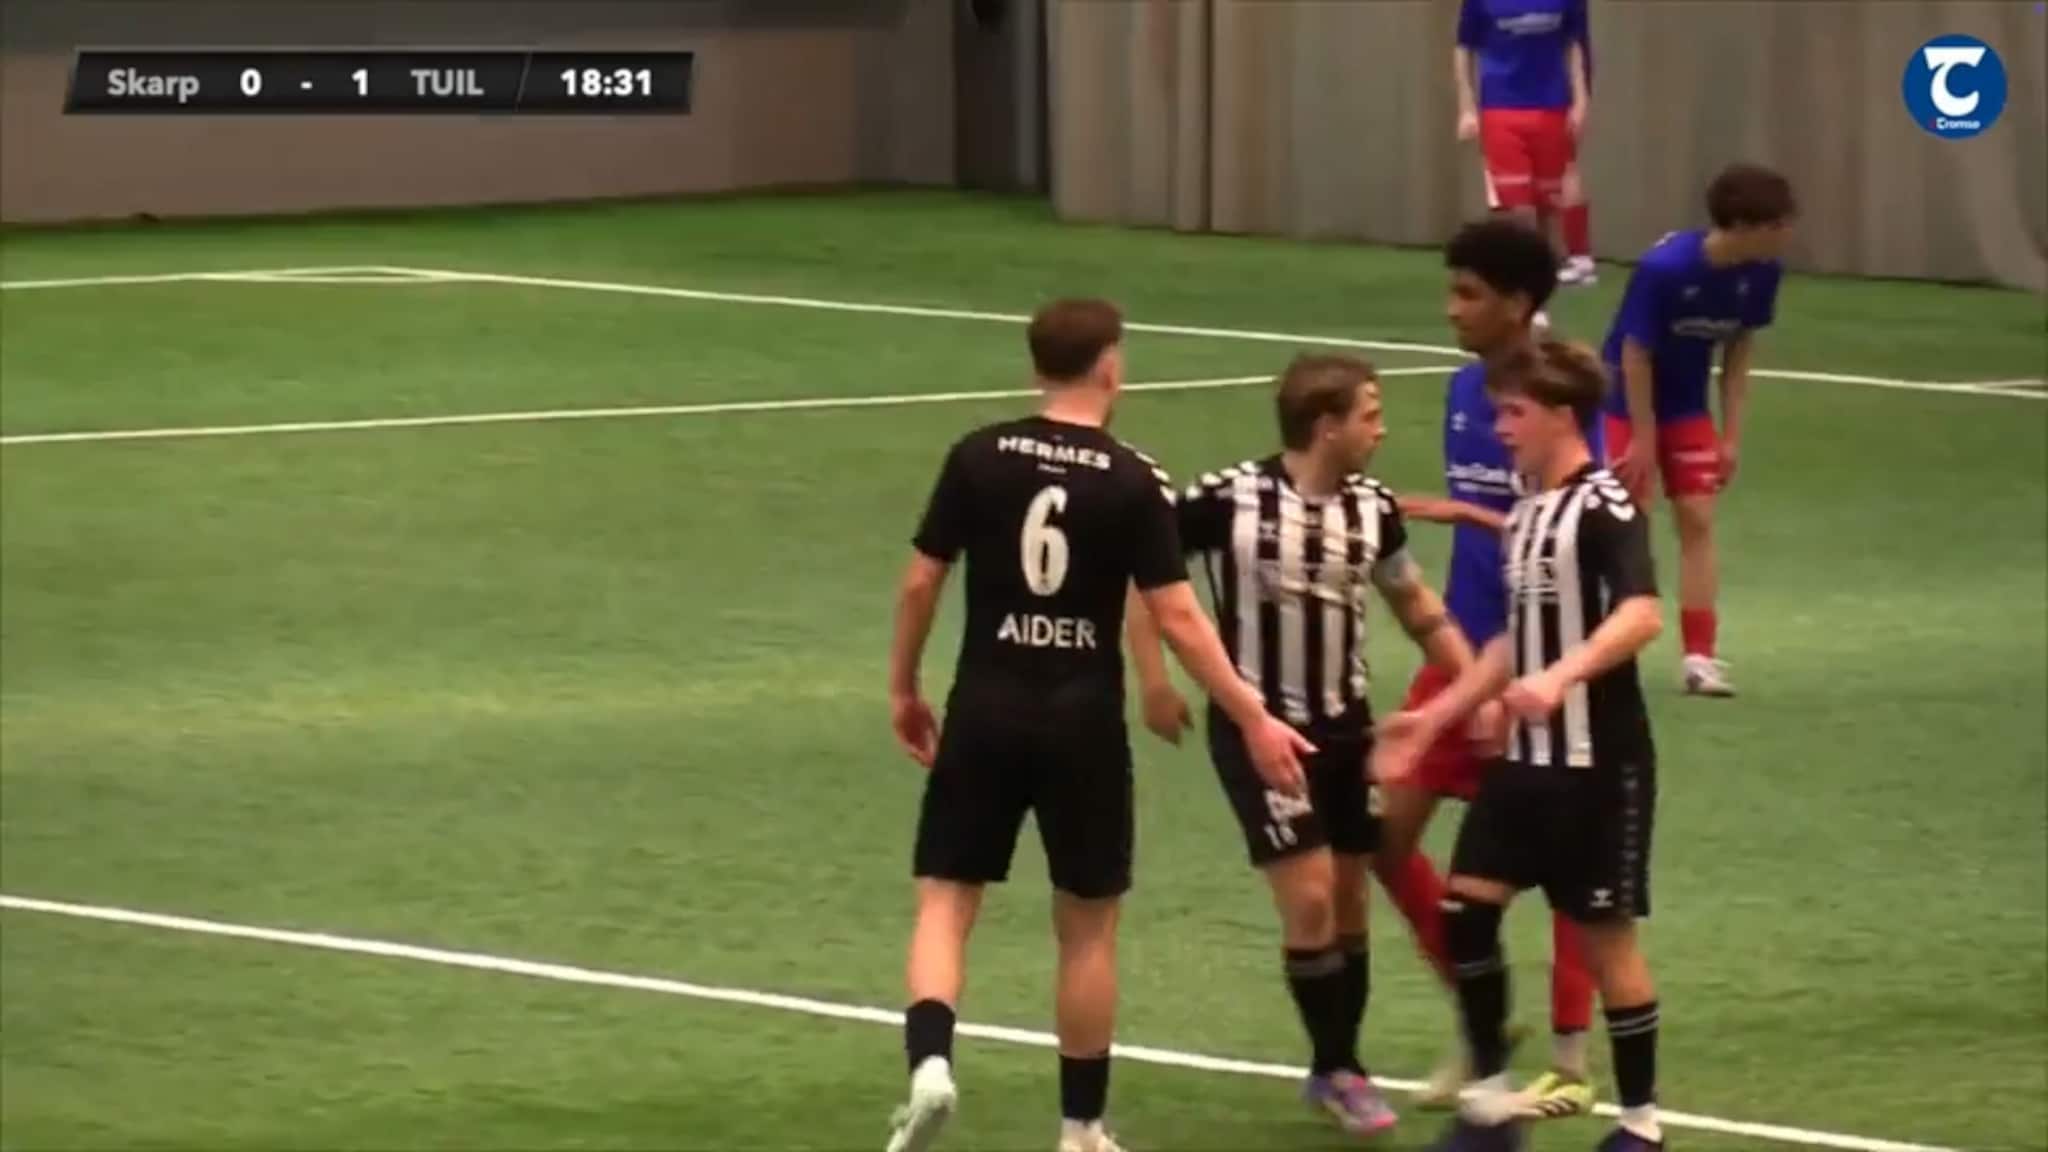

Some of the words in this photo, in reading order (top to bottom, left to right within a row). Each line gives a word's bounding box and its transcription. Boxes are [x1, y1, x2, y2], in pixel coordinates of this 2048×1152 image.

[997, 436, 1112, 471] HERMES
[1020, 485, 1070, 597] 6
[997, 613, 1097, 649] AIDER
